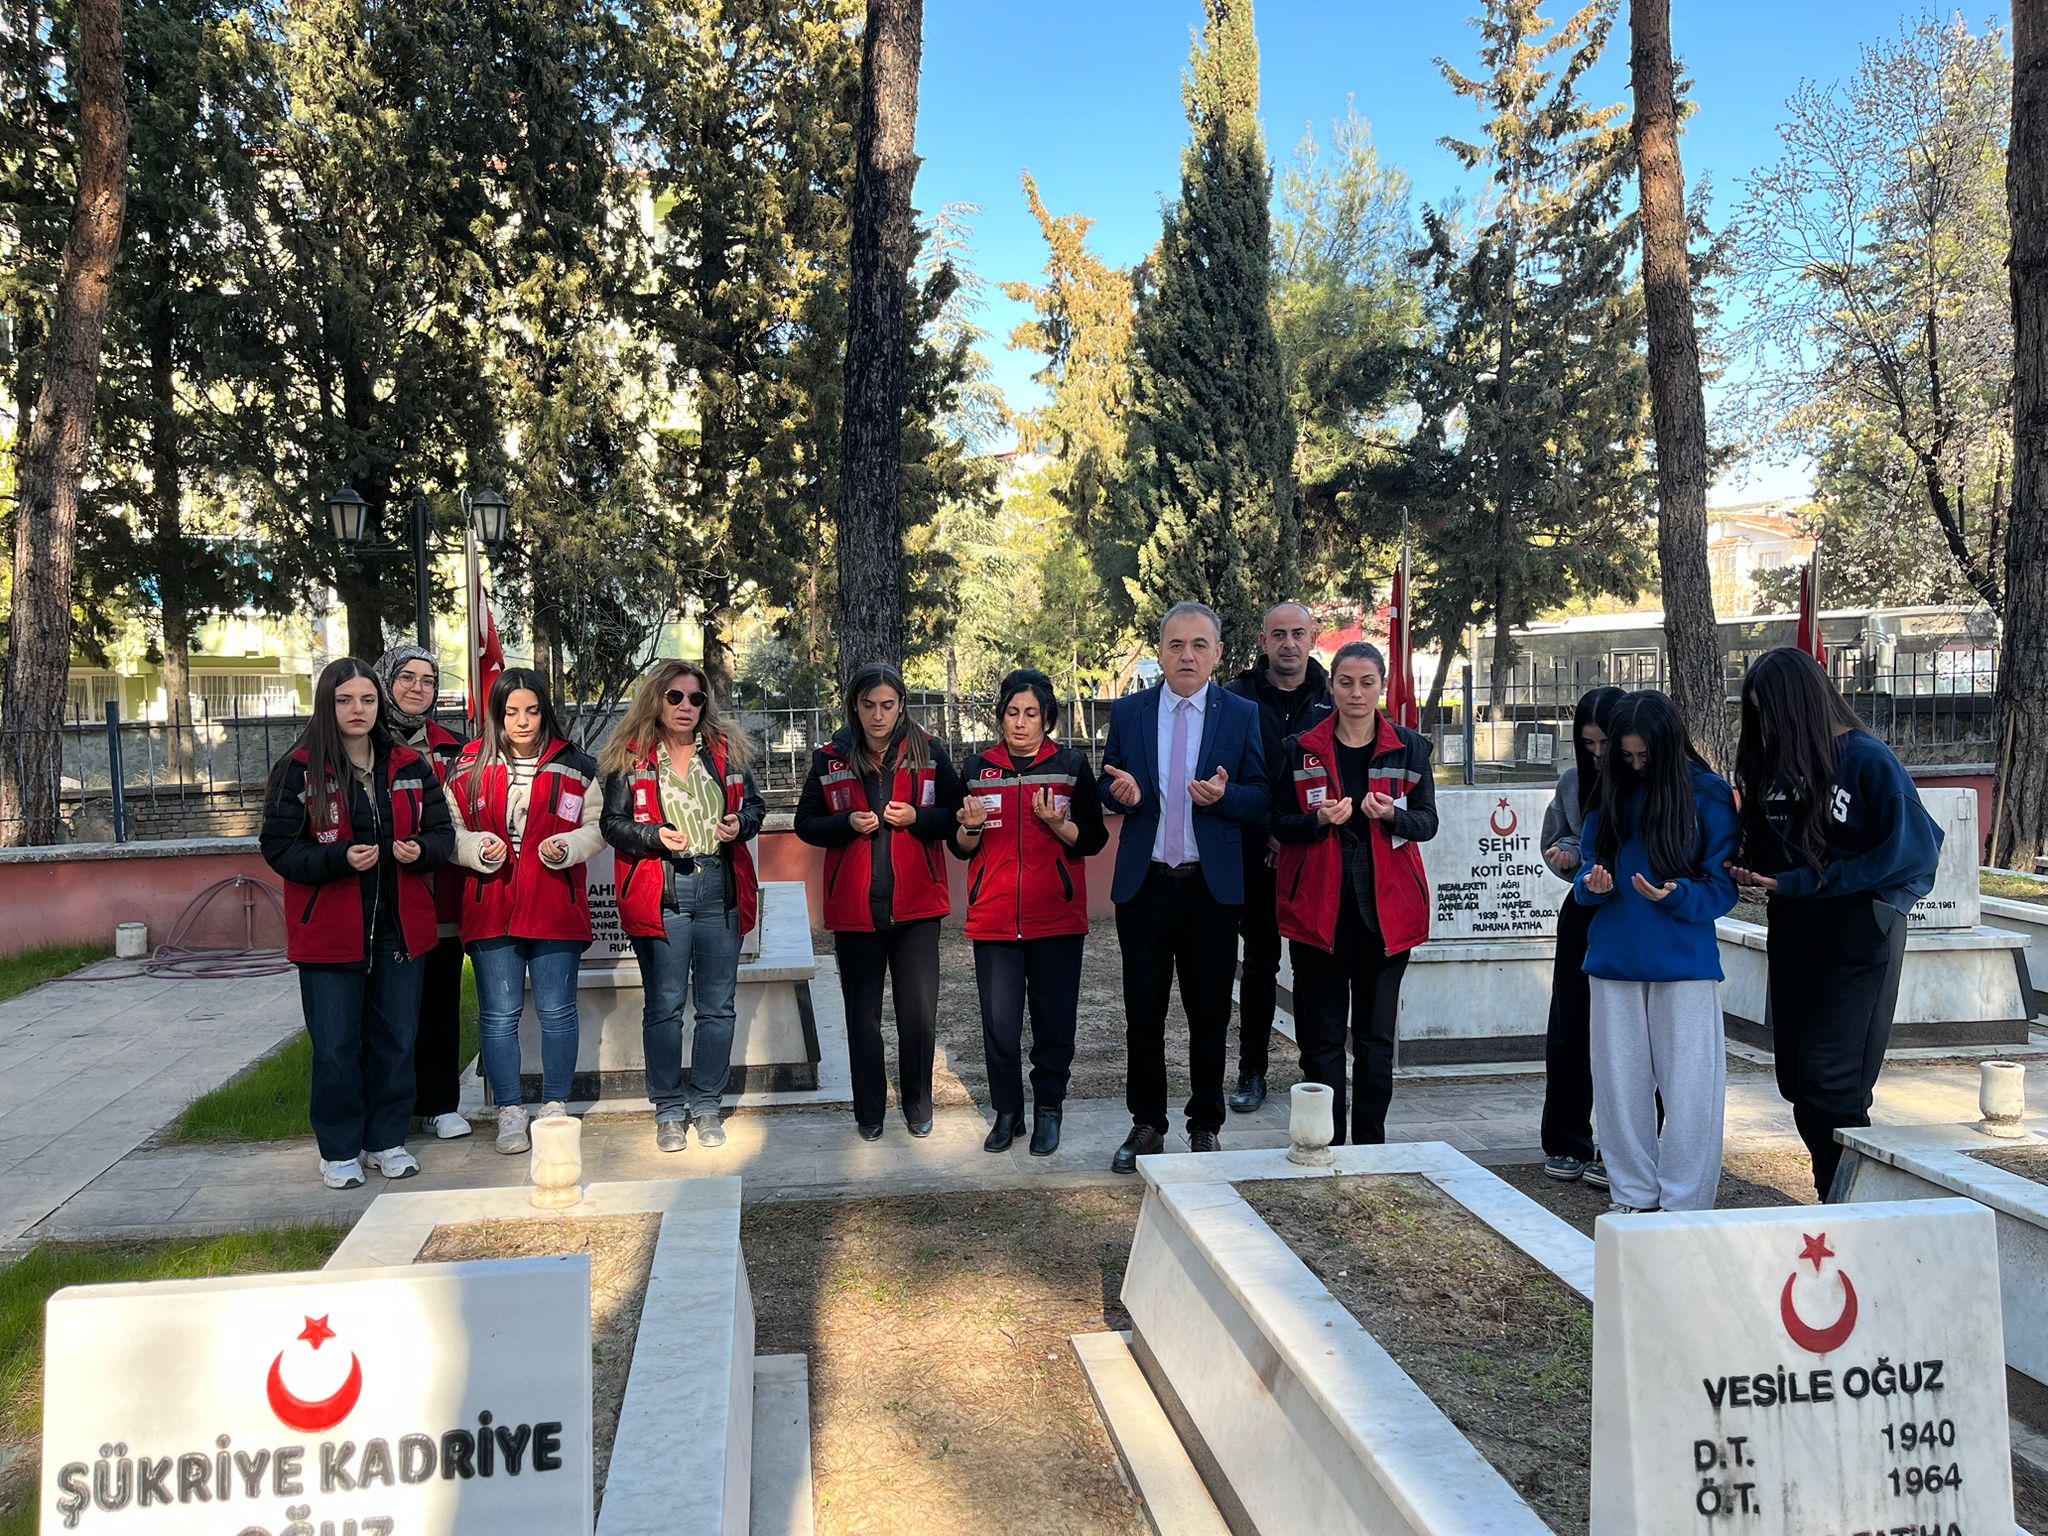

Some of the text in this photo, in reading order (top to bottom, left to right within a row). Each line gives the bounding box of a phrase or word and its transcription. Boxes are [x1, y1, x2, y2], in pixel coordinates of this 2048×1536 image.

[1478, 834, 1531, 856] ŞEHİT
[1498, 852, 1512, 862] ER
[1471, 863, 1544, 878] KOTİ GENÇ
[1500, 880, 1520, 889] AĞRI
[1438, 893, 1462, 901] BABA
[1463, 893, 1479, 901] ADI
[1438, 902, 1463, 911] ANNE
[1464, 902, 1479, 910] ADI
[1501, 900, 1532, 910] NAFİZE
[1438, 913, 1454, 921] D.T.
[1477, 911, 1498, 920] 1939
[1472, 922, 1510, 931] RUHUNA
[609, 943, 632, 953] RUH
[1703, 1357, 1945, 1410] VESİLE OĞUZ
[1694, 1418, 1956, 1473] D.T. 1940
[57, 1410, 563, 1529] ŞÜKRİYE KADRİYE
[1696, 1463, 1963, 1516] Ö.T. 1964
